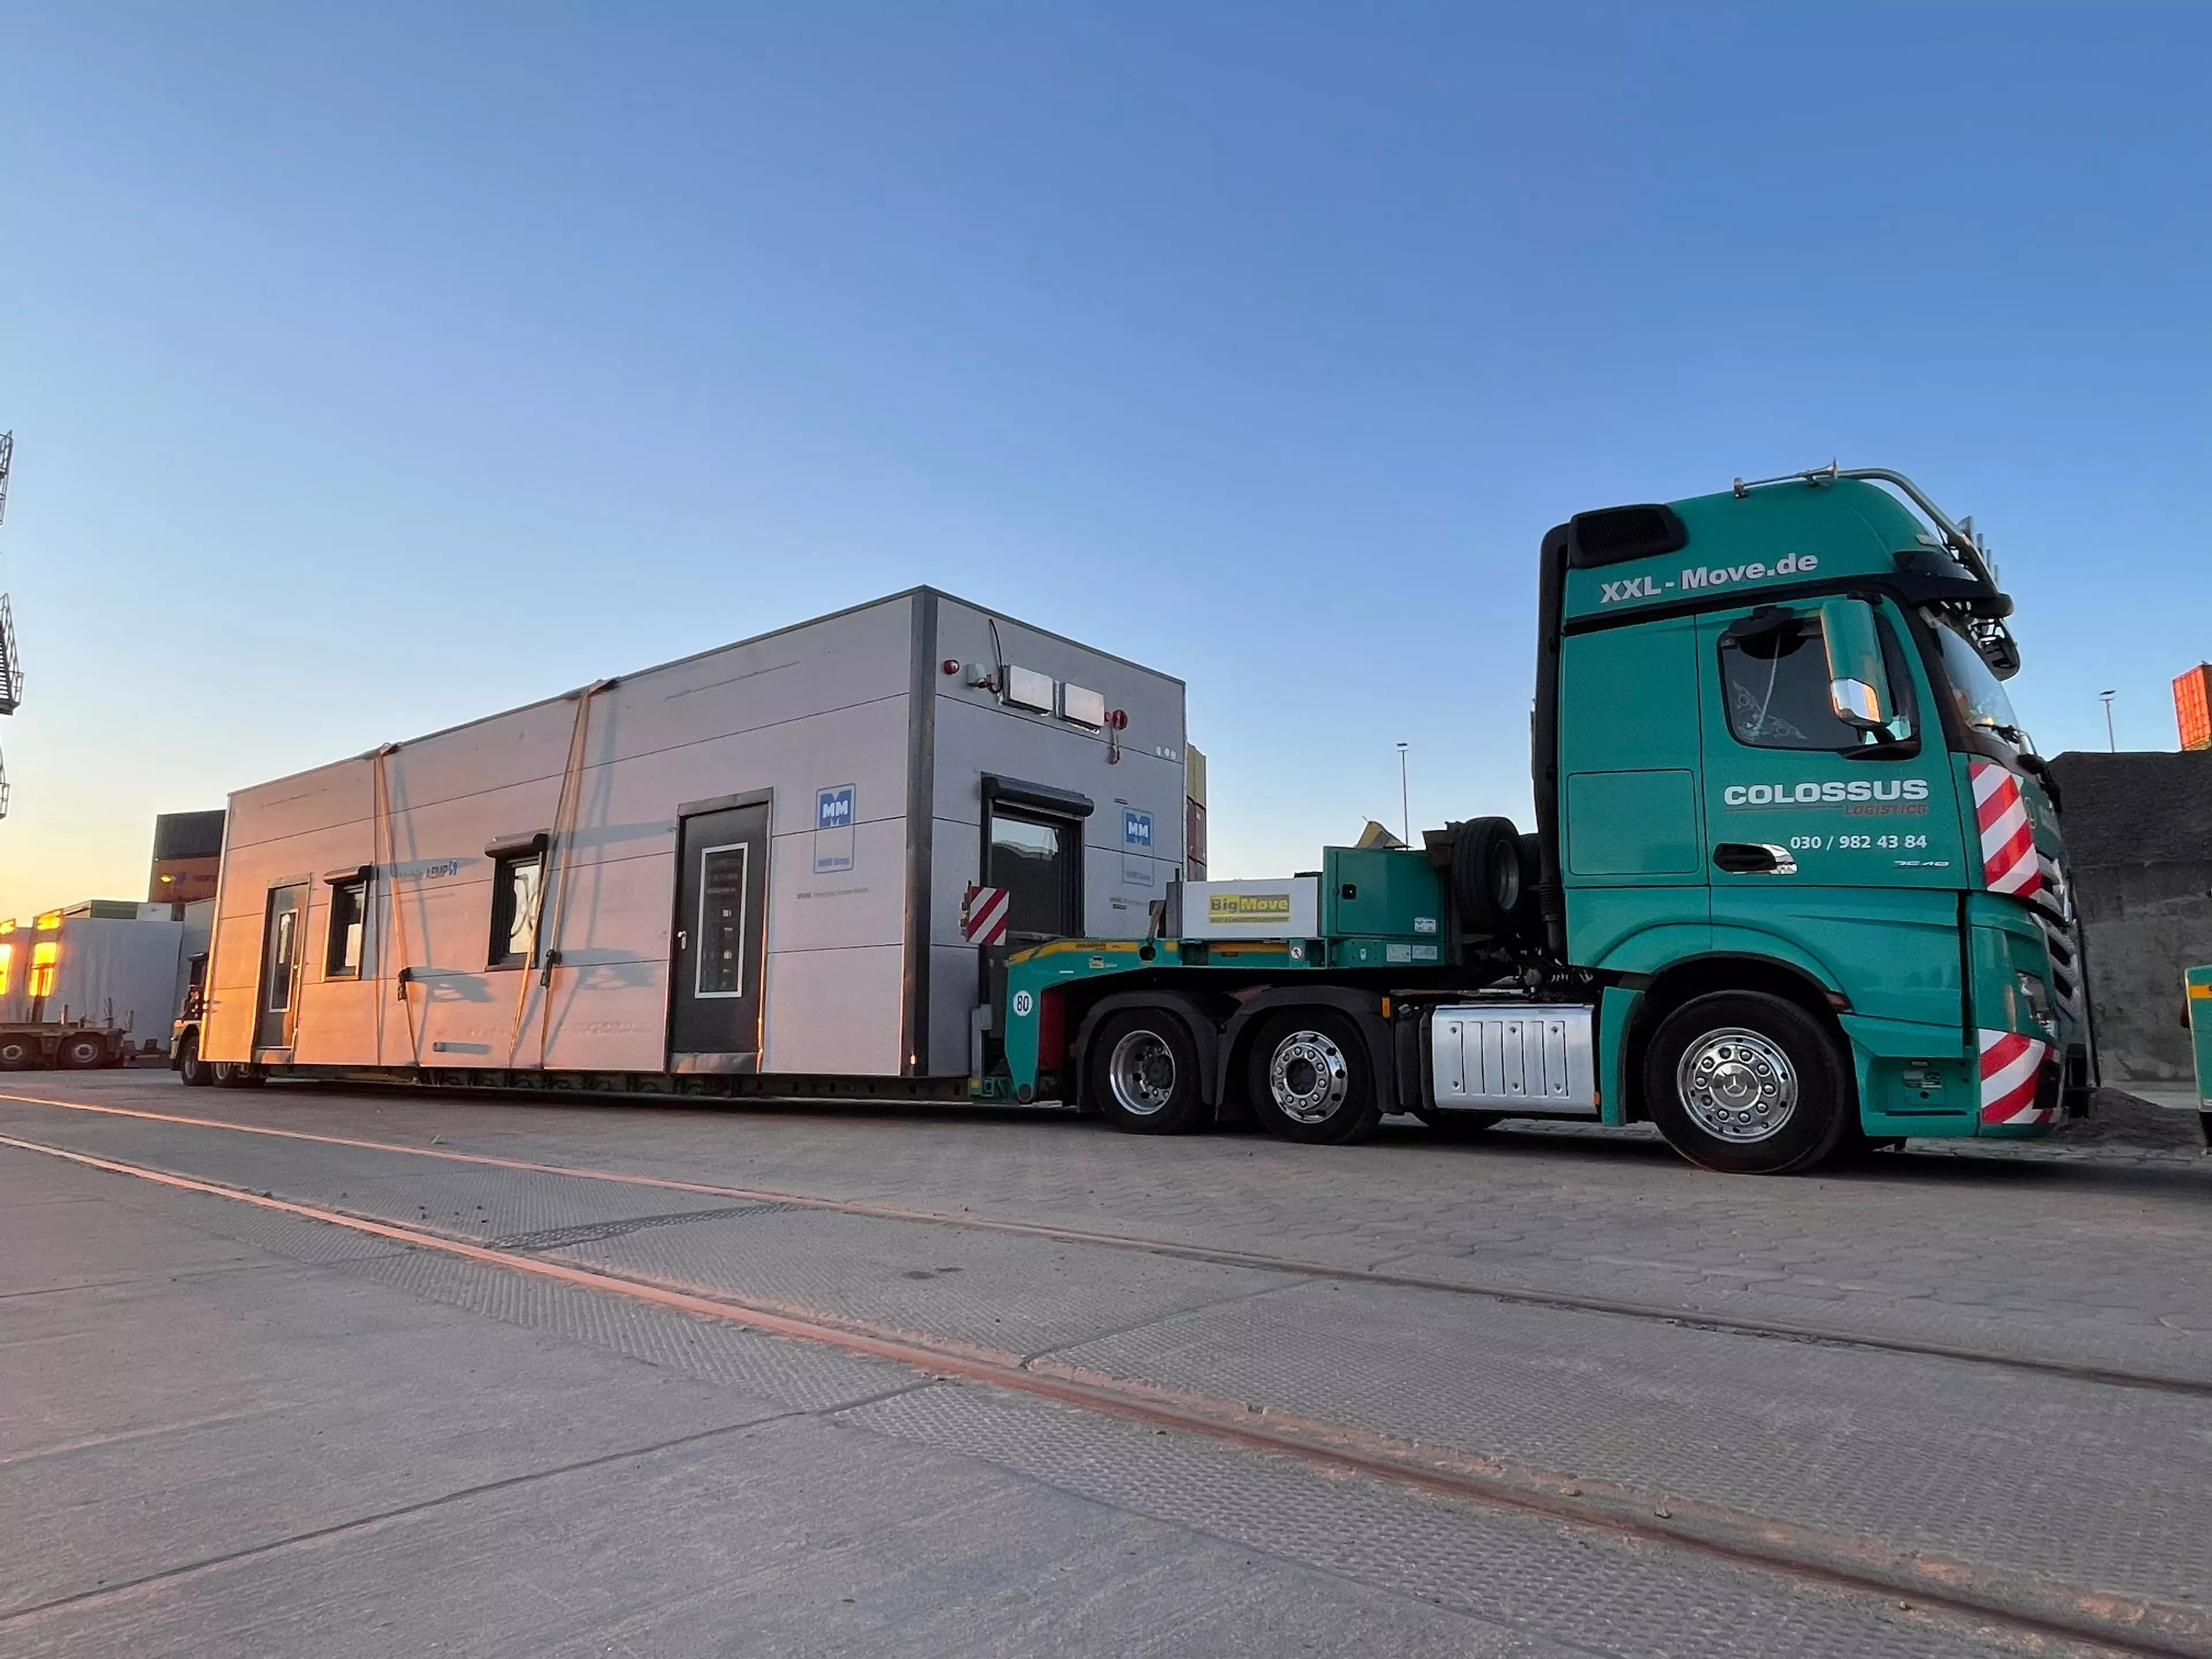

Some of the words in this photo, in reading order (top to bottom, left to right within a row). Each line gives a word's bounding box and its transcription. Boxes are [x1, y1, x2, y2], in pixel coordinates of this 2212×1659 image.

[1724, 779, 1930, 805] COLOSSUS
[1845, 804, 1927, 815] LOGISTICS
[1790, 835, 1822, 849] 030
[1826, 835, 1835, 851] /
[1839, 835, 1872, 849] 982
[1876, 835, 1900, 849] 43
[1904, 835, 1927, 849] 84
[1017, 995, 1029, 1012] 80
